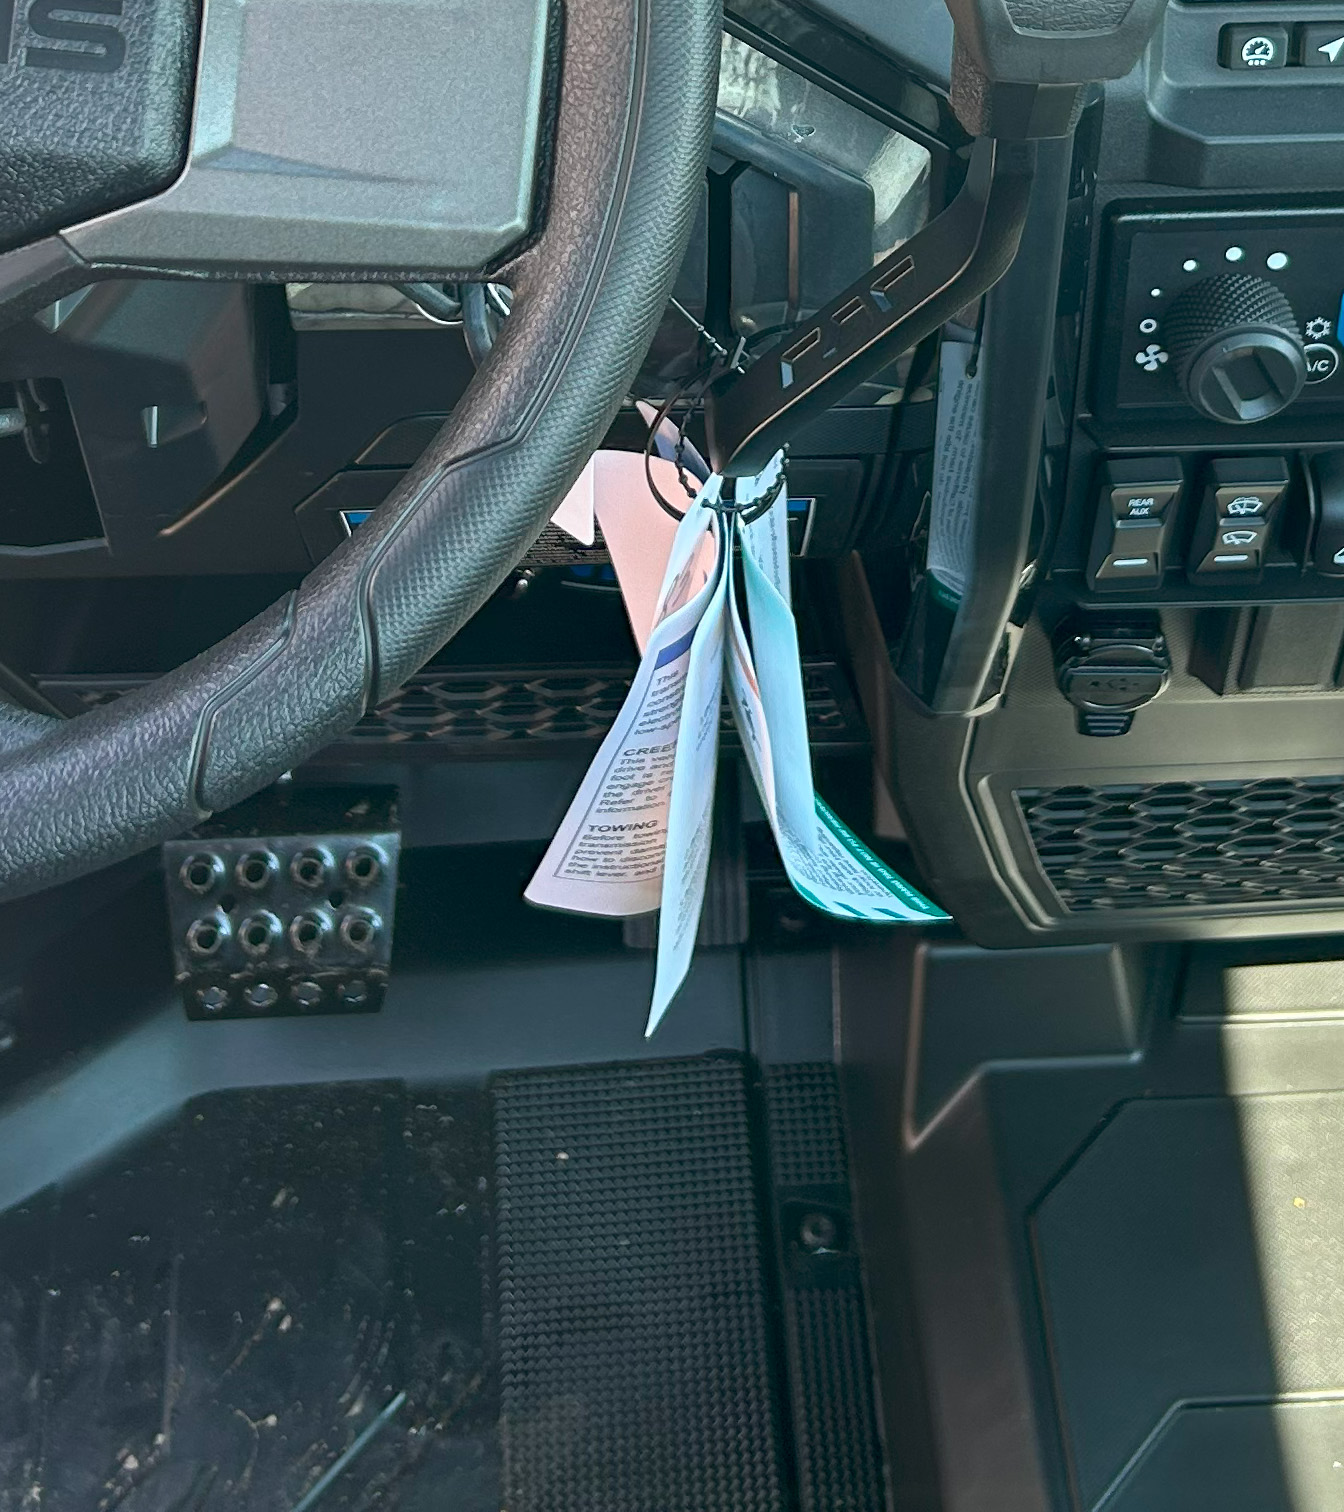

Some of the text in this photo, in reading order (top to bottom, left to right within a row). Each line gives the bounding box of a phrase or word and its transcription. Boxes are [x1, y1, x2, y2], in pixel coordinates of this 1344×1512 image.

[1128, 497, 1154, 507] REAR
[1129, 507, 1150, 516] AUX
[588, 819, 658, 833] TOWING
